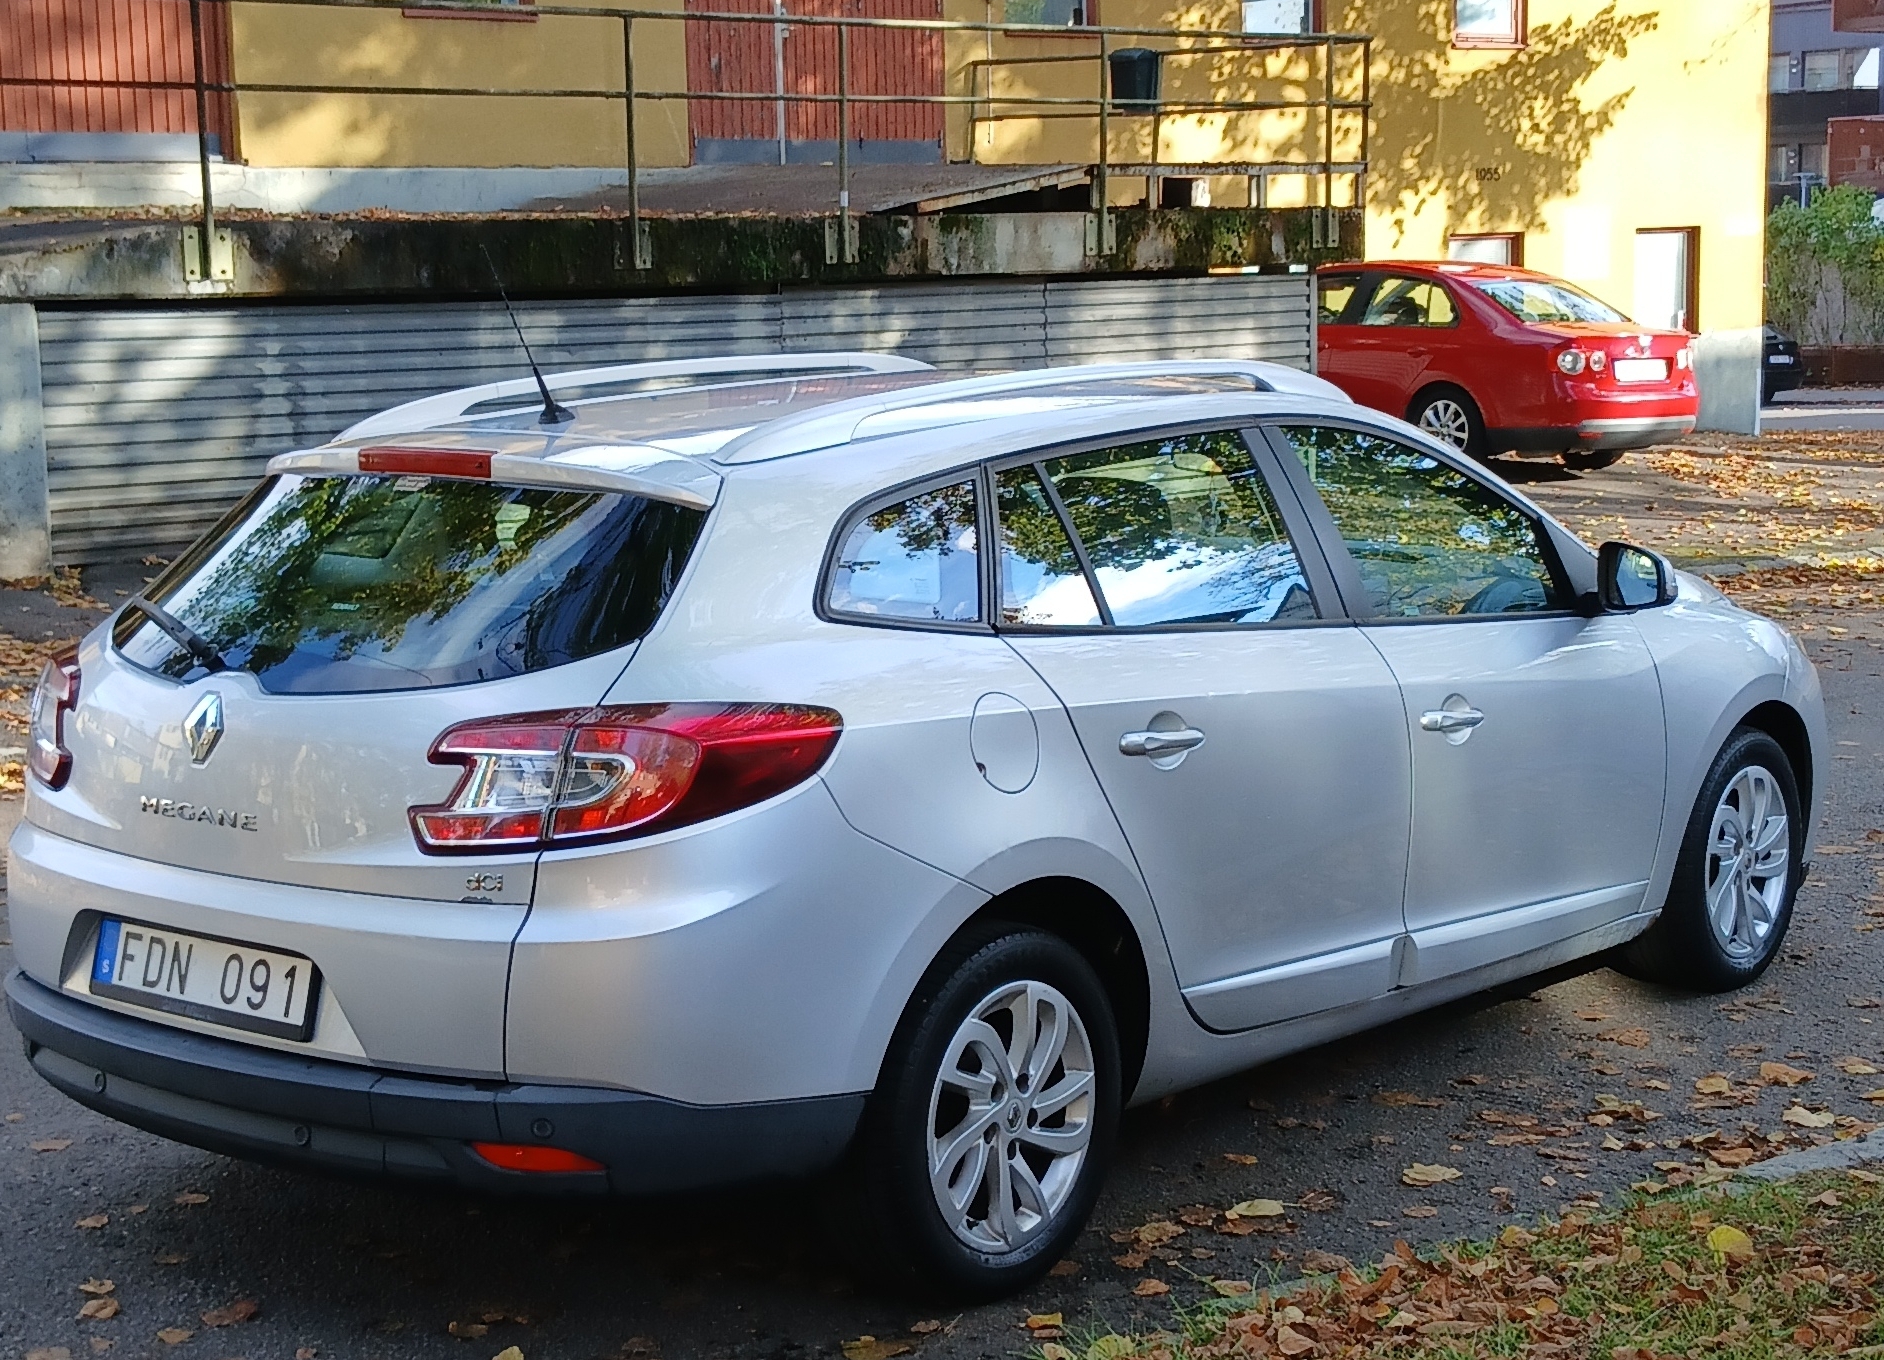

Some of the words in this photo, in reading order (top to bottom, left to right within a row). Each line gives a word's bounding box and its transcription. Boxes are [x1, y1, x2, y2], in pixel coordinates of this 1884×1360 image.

[140, 795, 258, 831] MEGANE
[118, 931, 193, 995] FDN
[220, 953, 297, 1018] 091
